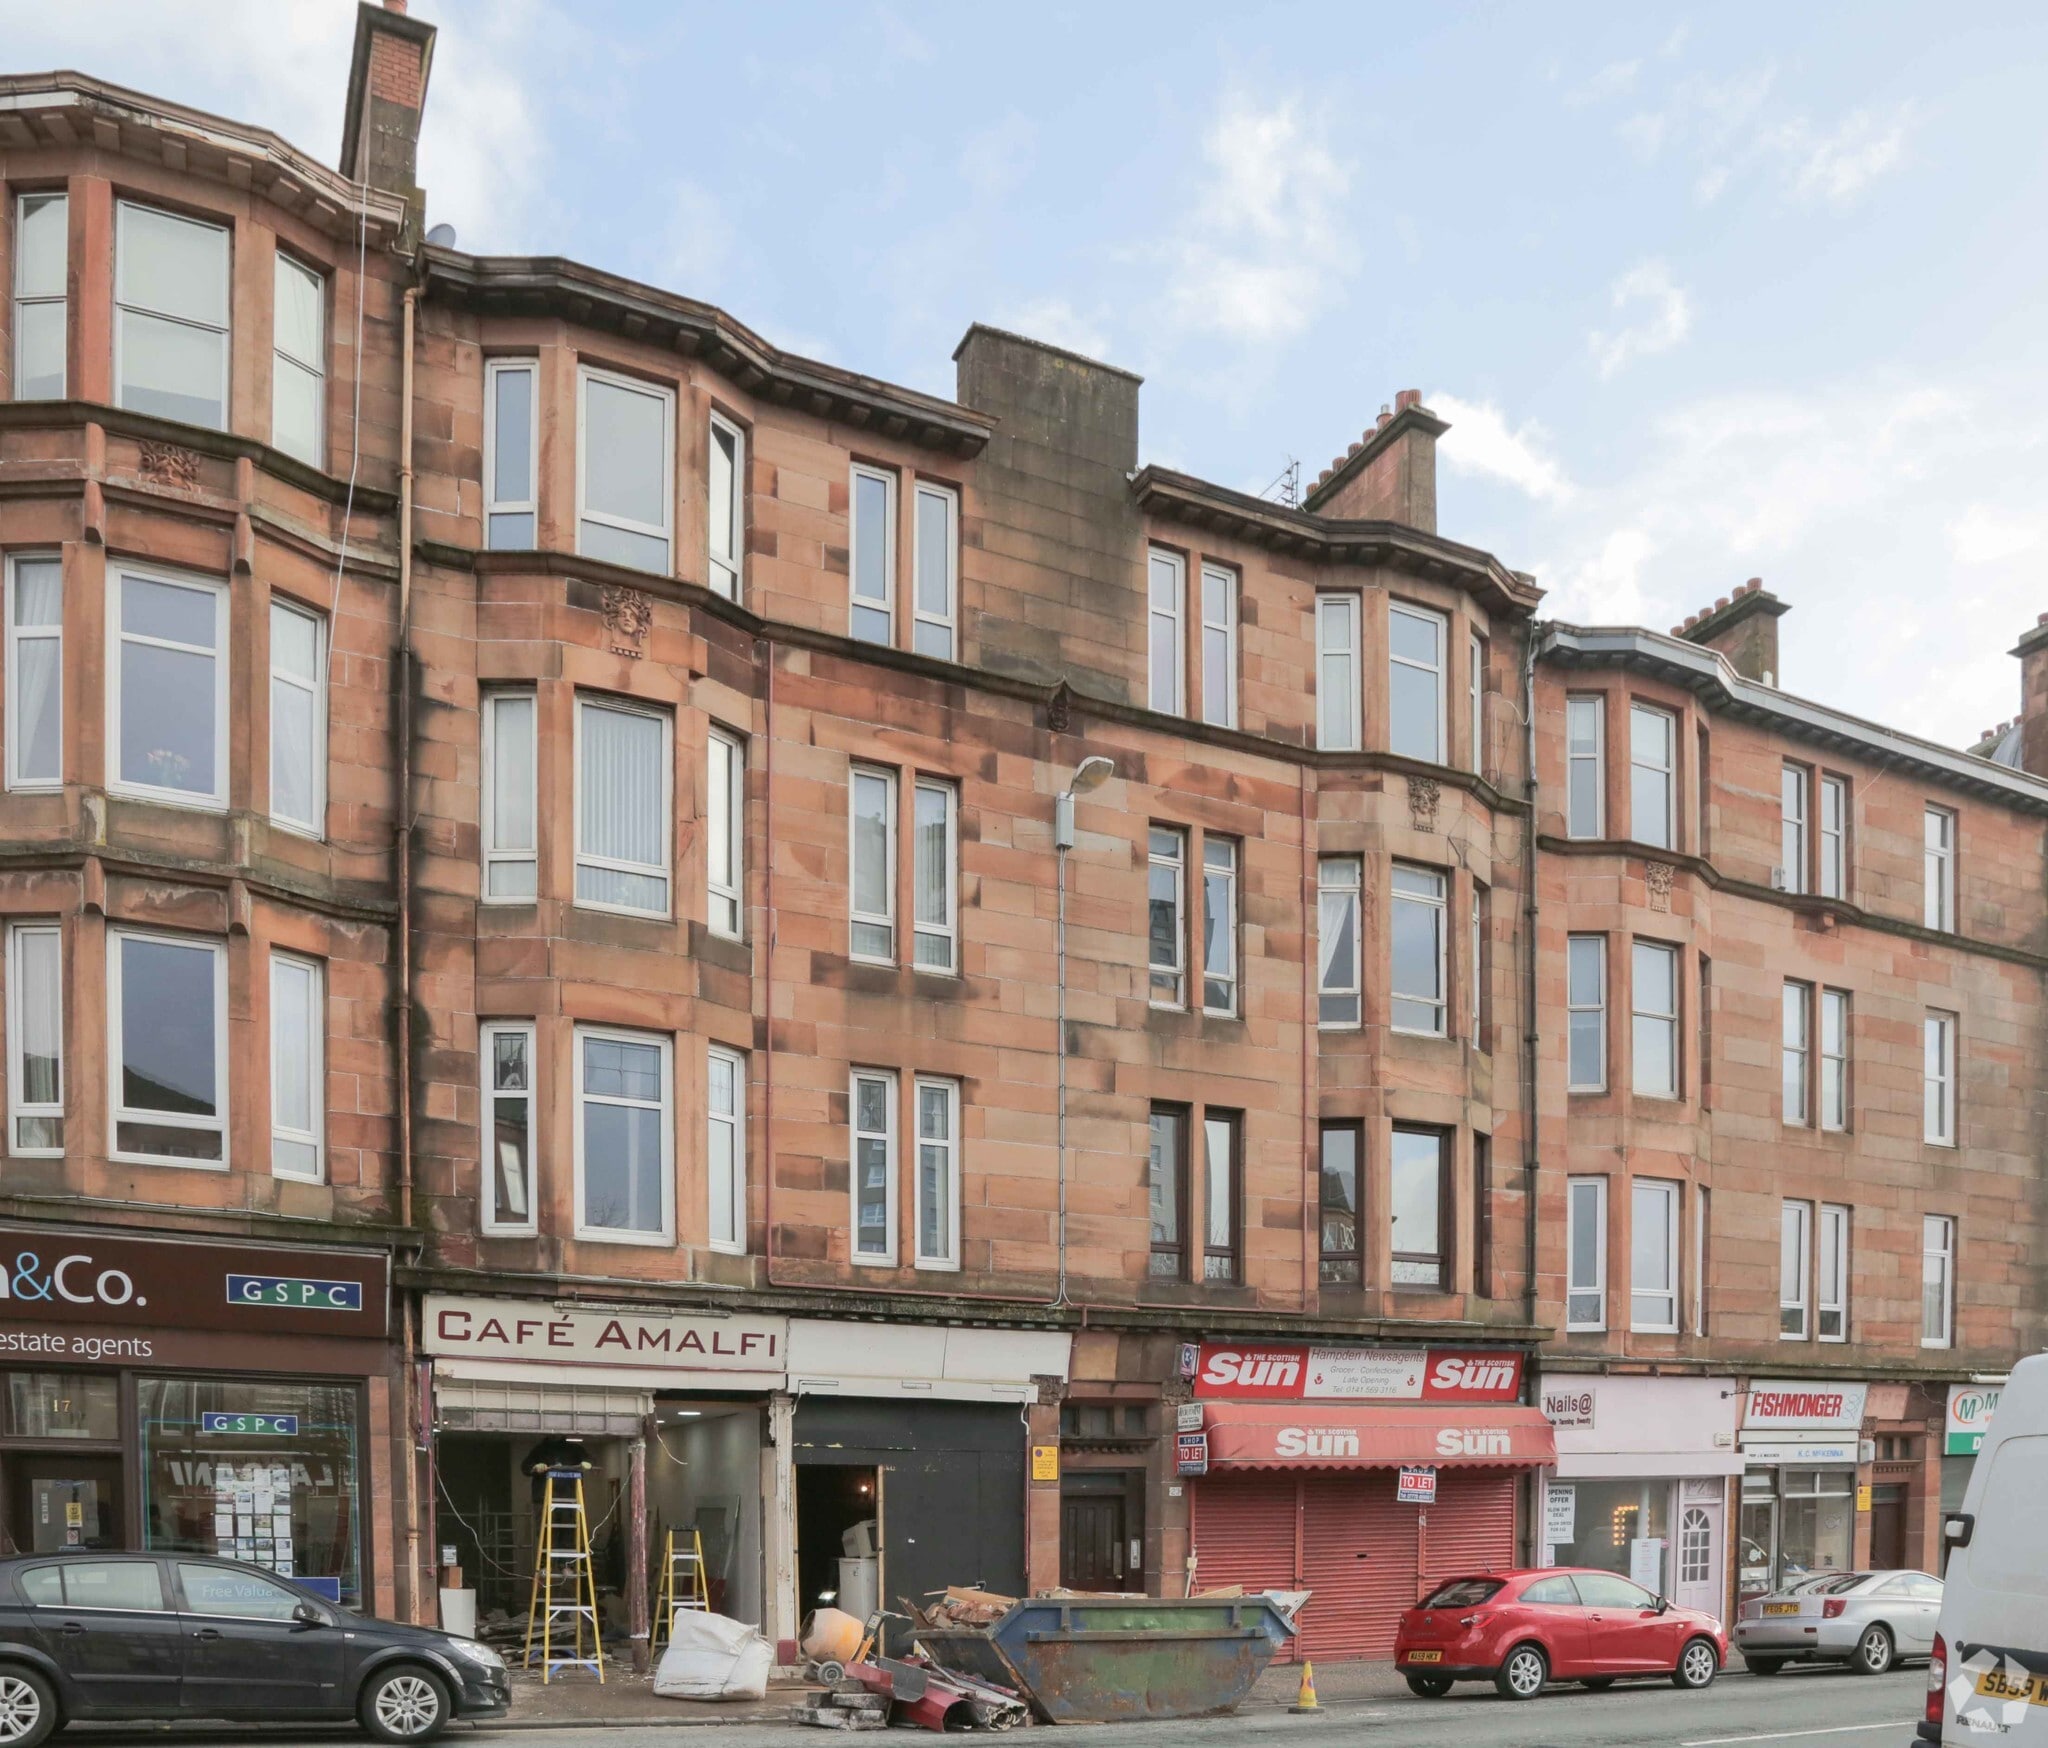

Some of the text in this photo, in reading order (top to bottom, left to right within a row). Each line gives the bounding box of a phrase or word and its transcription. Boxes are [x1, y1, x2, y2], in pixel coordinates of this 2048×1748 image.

[242, 1281, 347, 1306] GSPC
[0, 1331, 153, 1361] estate agents
[594, 1319, 776, 1357] AMALFI
[1253, 1353, 1300, 1362] THE SCOTTISH
[1311, 1348, 1425, 1365] Hampden Newsagents
[1474, 1359, 1516, 1368] THE SCOTTISH
[1202, 1352, 1300, 1386] Sun
[1360, 1366, 1404, 1375] Confectioner
[1430, 1358, 1515, 1390] Sun
[1342, 1376, 1390, 1386] Late Opening
[53, 1399, 71, 1412] 17
[1546, 1393, 1592, 1415] Nails@
[1750, 1393, 1844, 1417] FISHMONGER
[213, 1416, 288, 1433] GSPC
[1274, 1427, 1360, 1457] Sun
[1435, 1428, 1511, 1456] Sun
[1179, 1447, 1204, 1460] TO LET
[1402, 1475, 1433, 1489] TO LET
[1549, 1496, 1569, 1504] OFFER
[202, 1584, 232, 1598] Free
[1983, 1671, 2035, 1697] SB59
[1955, 1714, 2011, 1734] RENAULT
